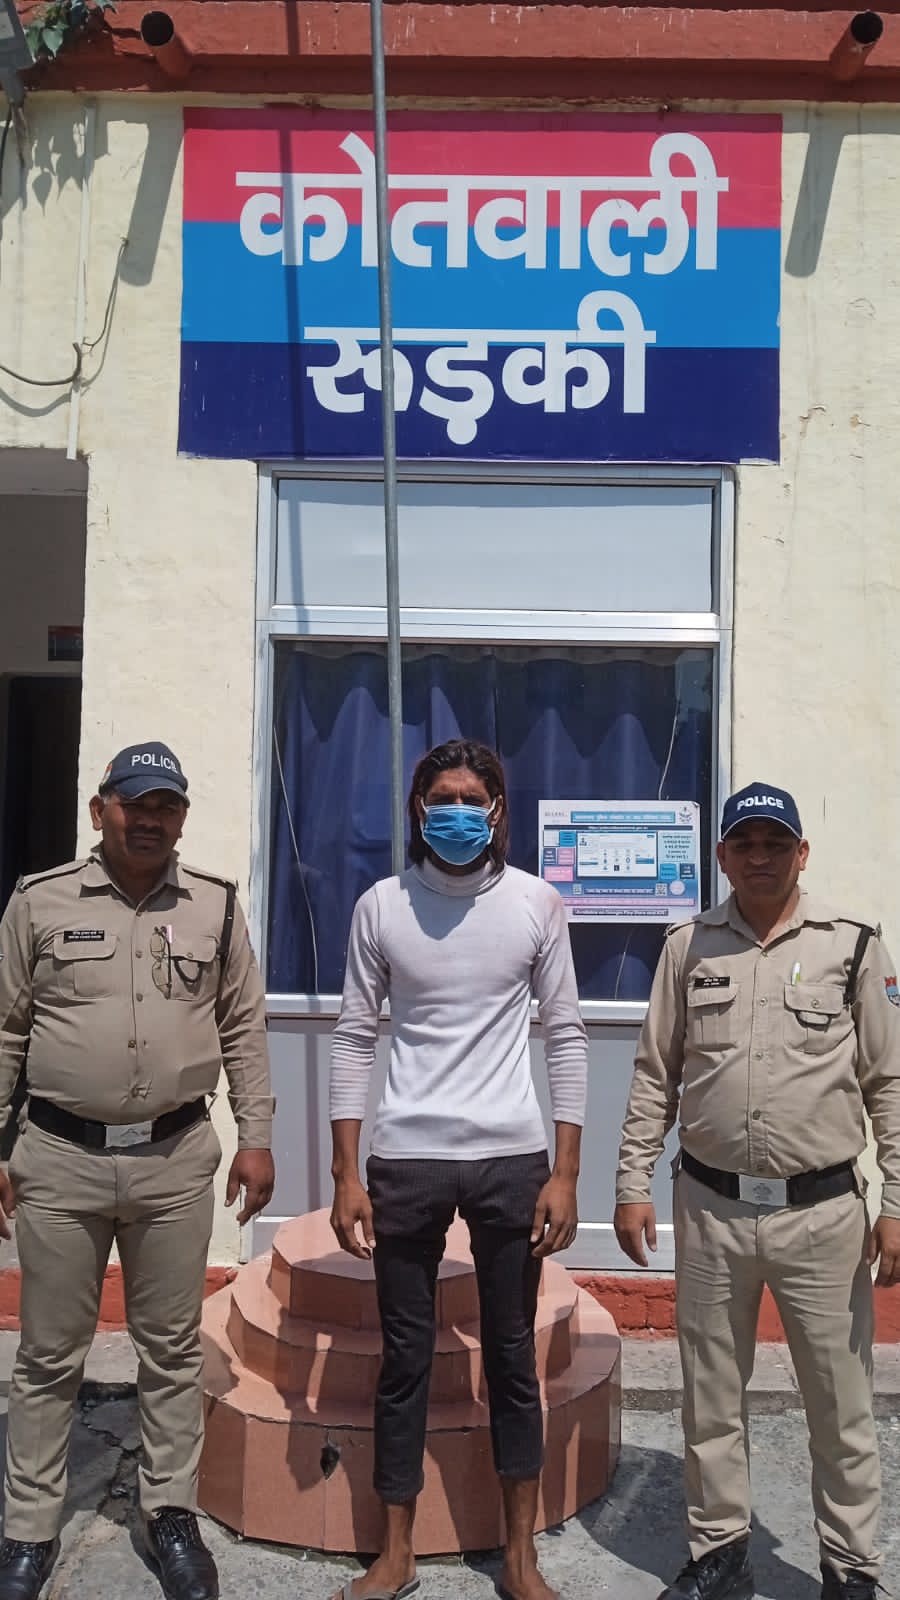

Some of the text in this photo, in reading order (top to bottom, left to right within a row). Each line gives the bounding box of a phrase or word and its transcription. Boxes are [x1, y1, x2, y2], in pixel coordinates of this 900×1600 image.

[235, 132, 729, 277] कोतवाली
[303, 290, 656, 445] रूड़की
[131, 753, 179, 774] POLICE
[736, 795, 785, 811] POLICE
